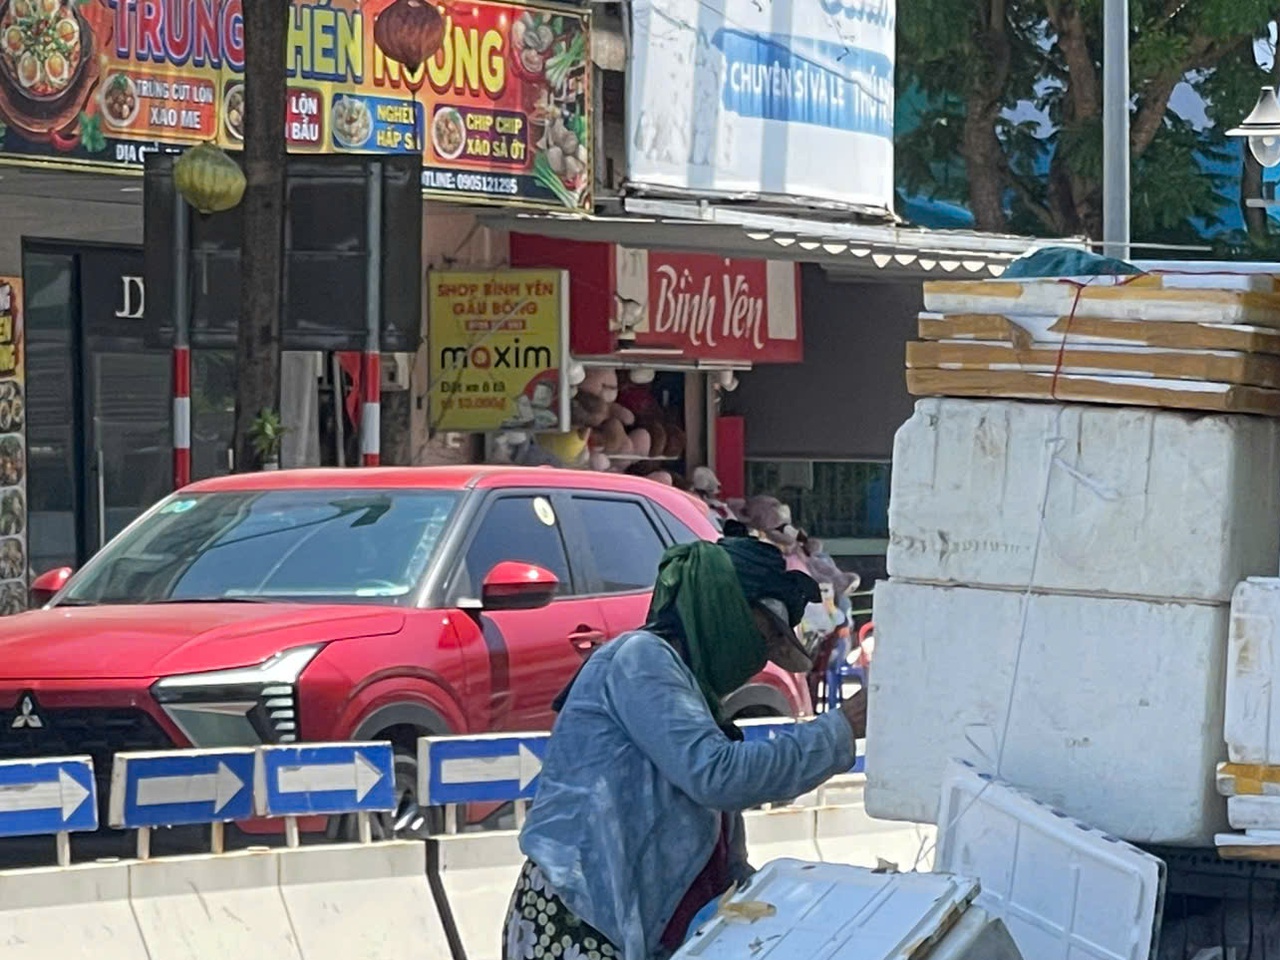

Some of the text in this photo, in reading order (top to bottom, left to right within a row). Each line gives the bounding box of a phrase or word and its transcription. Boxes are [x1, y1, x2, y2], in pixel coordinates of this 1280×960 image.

[286, 0, 363, 83] HÉN
[421, 171, 456, 189] OTLINE:
[438, 283, 478, 297] SHOP
[656, 258, 764, 349] Bình Yên
[441, 338, 551, 369] maxim
